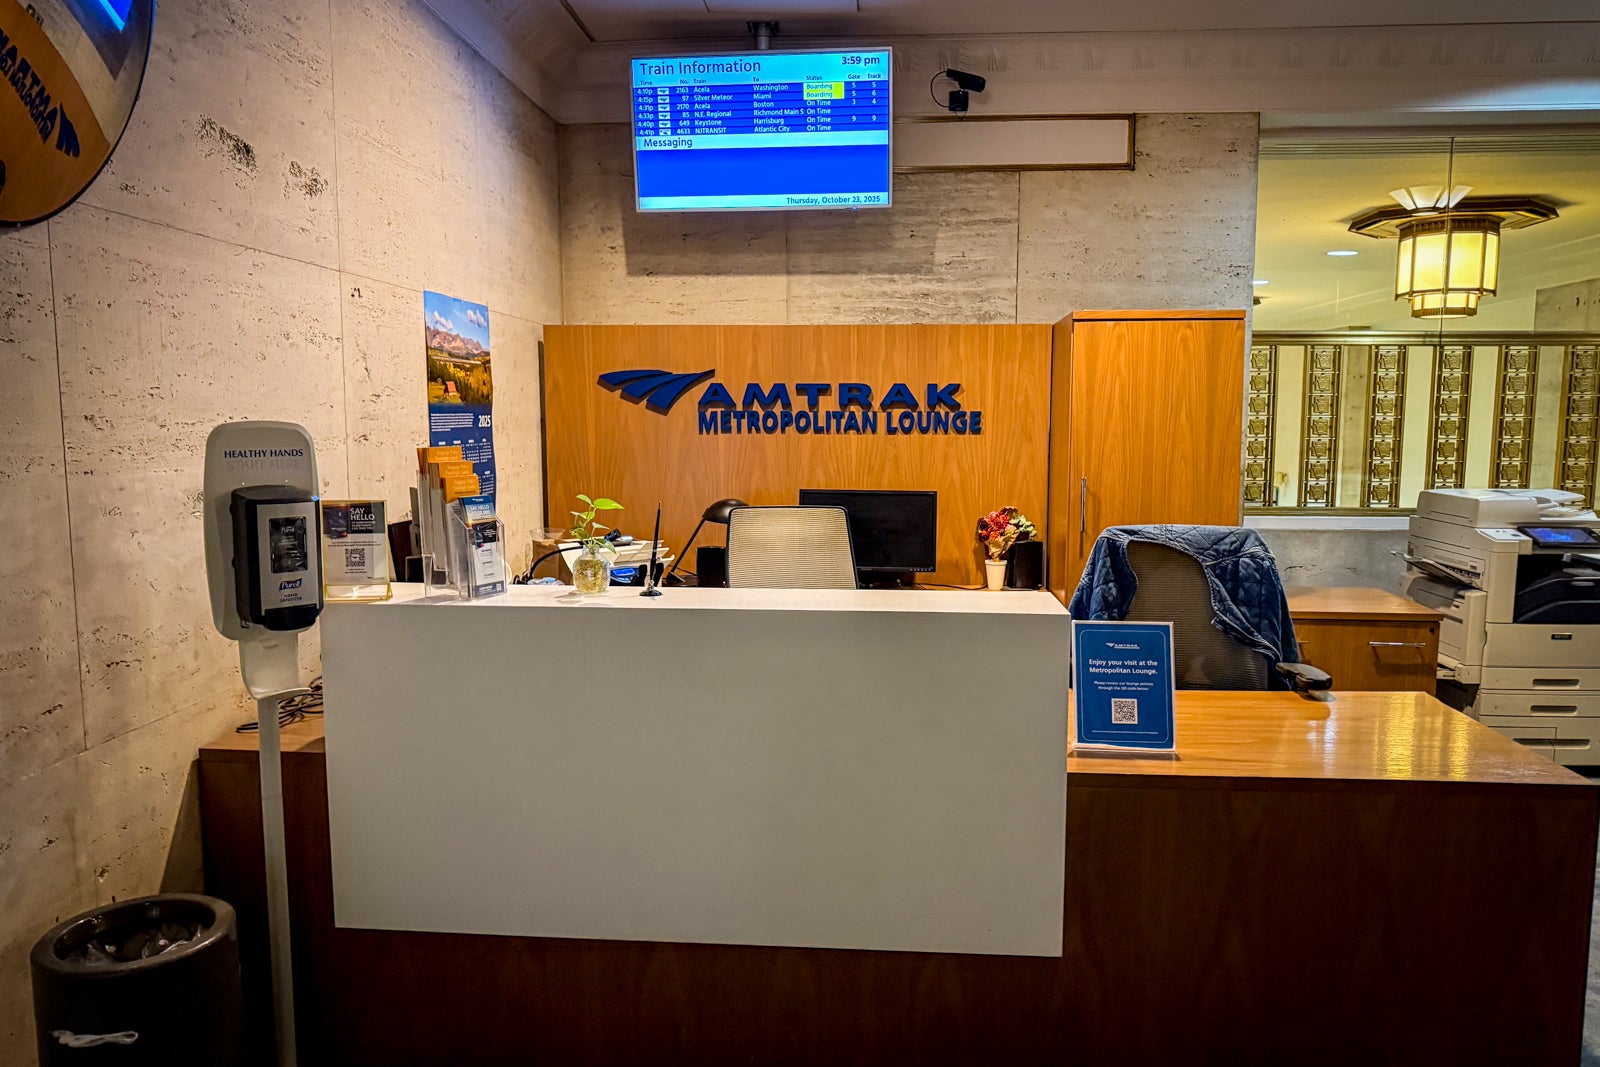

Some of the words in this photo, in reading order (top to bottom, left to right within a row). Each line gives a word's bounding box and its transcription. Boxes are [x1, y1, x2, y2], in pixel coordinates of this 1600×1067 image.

[640, 62, 674, 75] Train
[679, 59, 761, 73] Information
[842, 56, 861, 65] 3:59
[864, 57, 880, 66] pm
[644, 138, 693, 148] Messaging
[698, 382, 962, 410] AMTRAK
[479, 415, 491, 427] 2025
[699, 410, 878, 435] METROPOLITAN
[886, 410, 983, 435] LOUNGE
[224, 450, 267, 458] HEALTHY
[270, 448, 304, 457] HANDS
